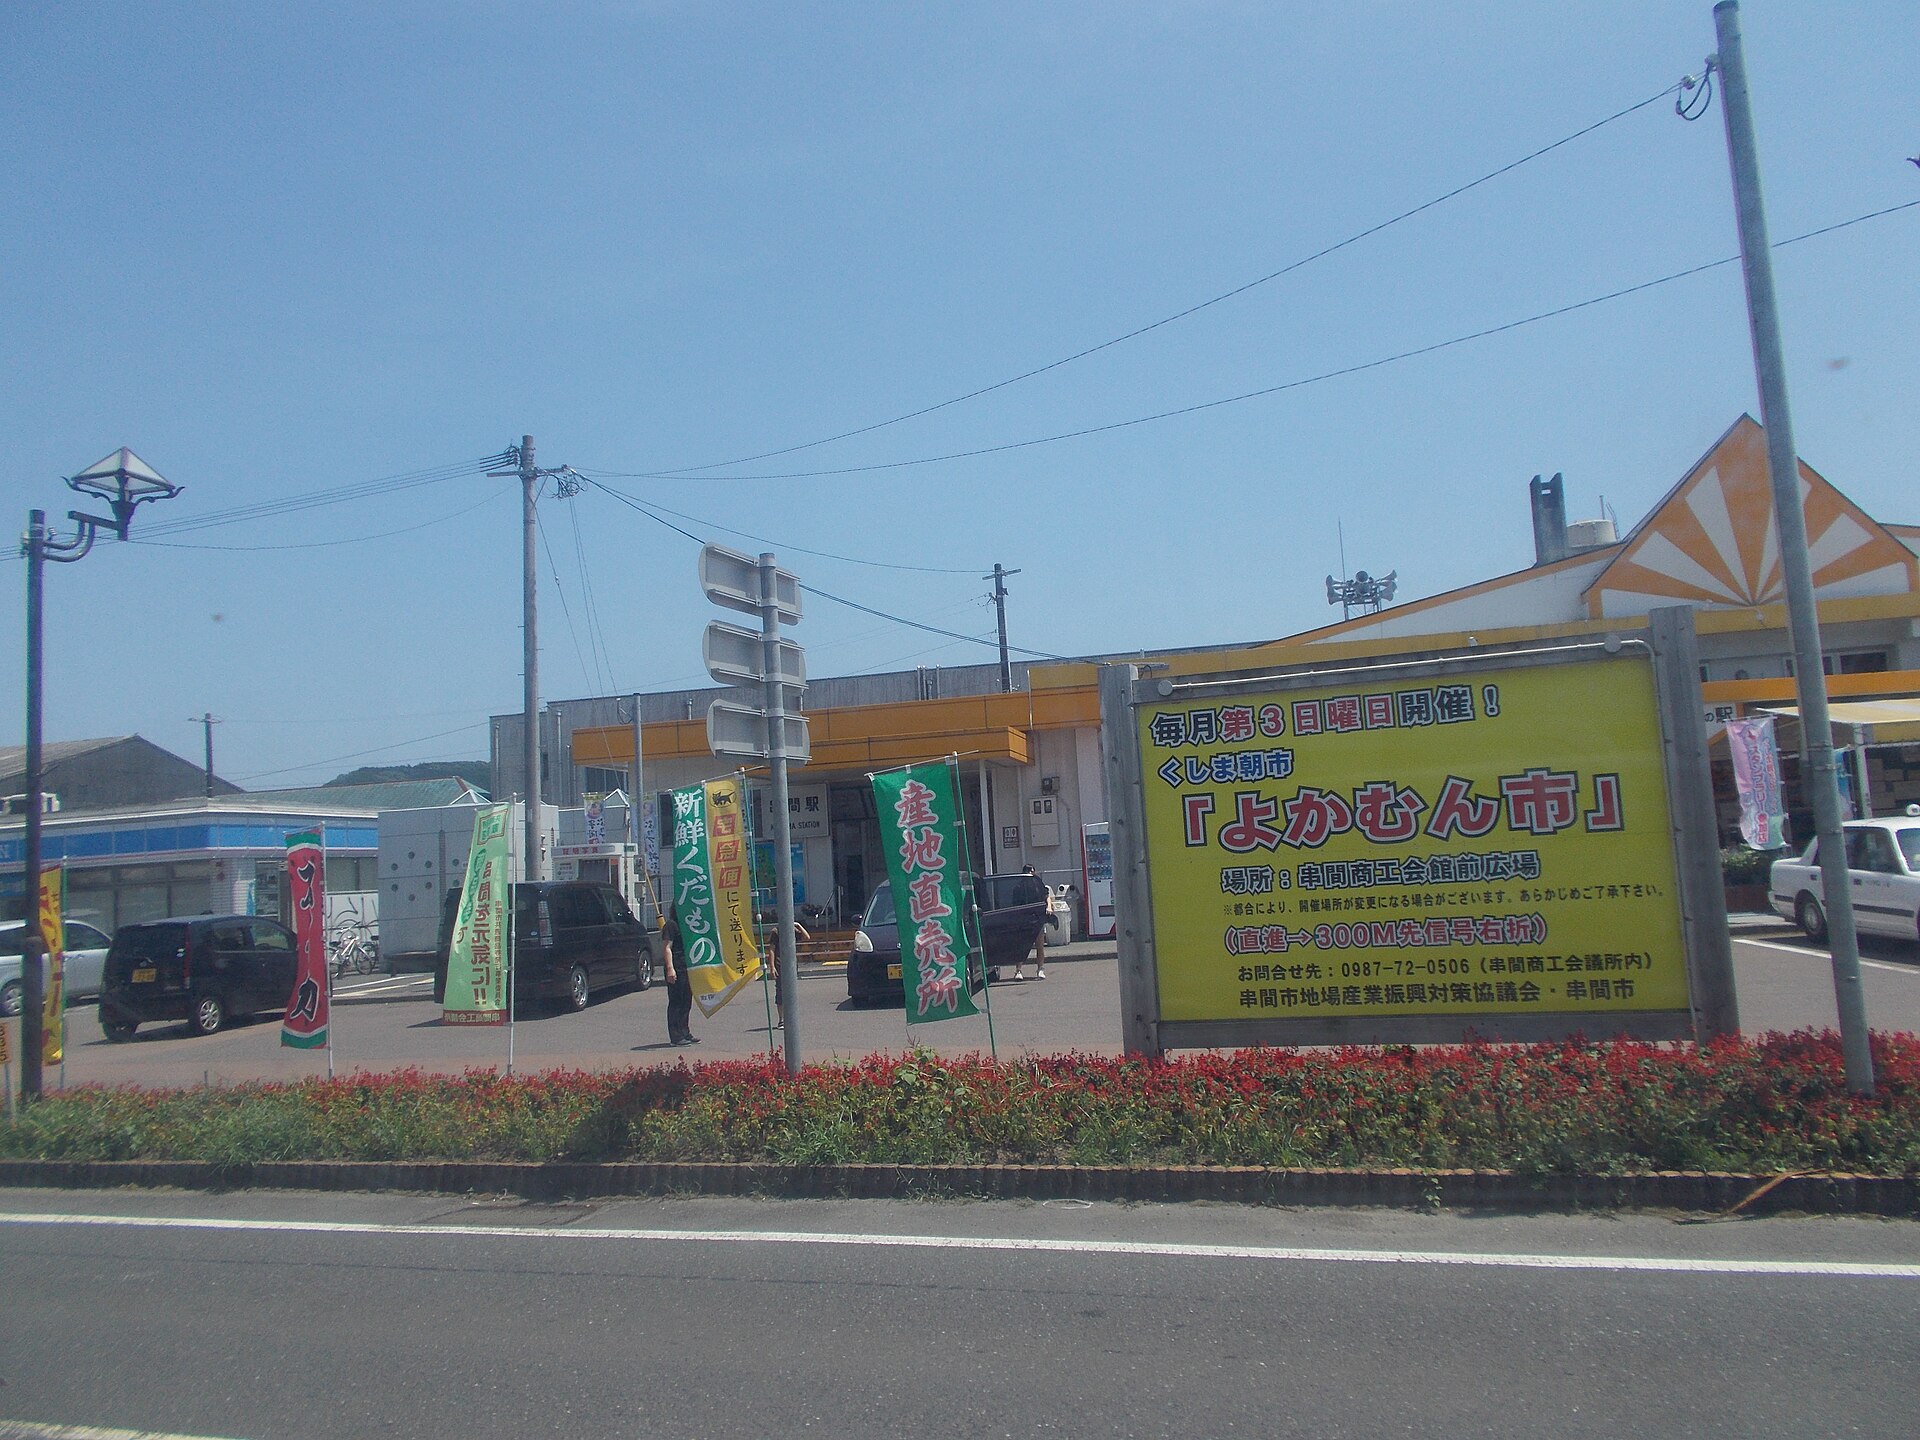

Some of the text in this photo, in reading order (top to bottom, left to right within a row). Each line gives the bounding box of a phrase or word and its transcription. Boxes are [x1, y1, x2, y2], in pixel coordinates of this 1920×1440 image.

[1149, 684, 1500, 748] 毎月第3日曜日開催！
[1158, 747, 1294, 789] くしま朝市
[769, 796, 819, 813] 間駅
[799, 821, 820, 829] STATION
[1182, 767, 1624, 853] 「よかむん市」
[674, 788, 717, 965] 新鮮くだもの
[713, 814, 748, 977] 宅急便にて送ります
[894, 779, 963, 1017] 産地直売所
[1220, 850, 1541, 895] 場所：串間商工会館前広場
[1240, 978, 1635, 1008] 串間市地場産業振興対策協議会・串間市
